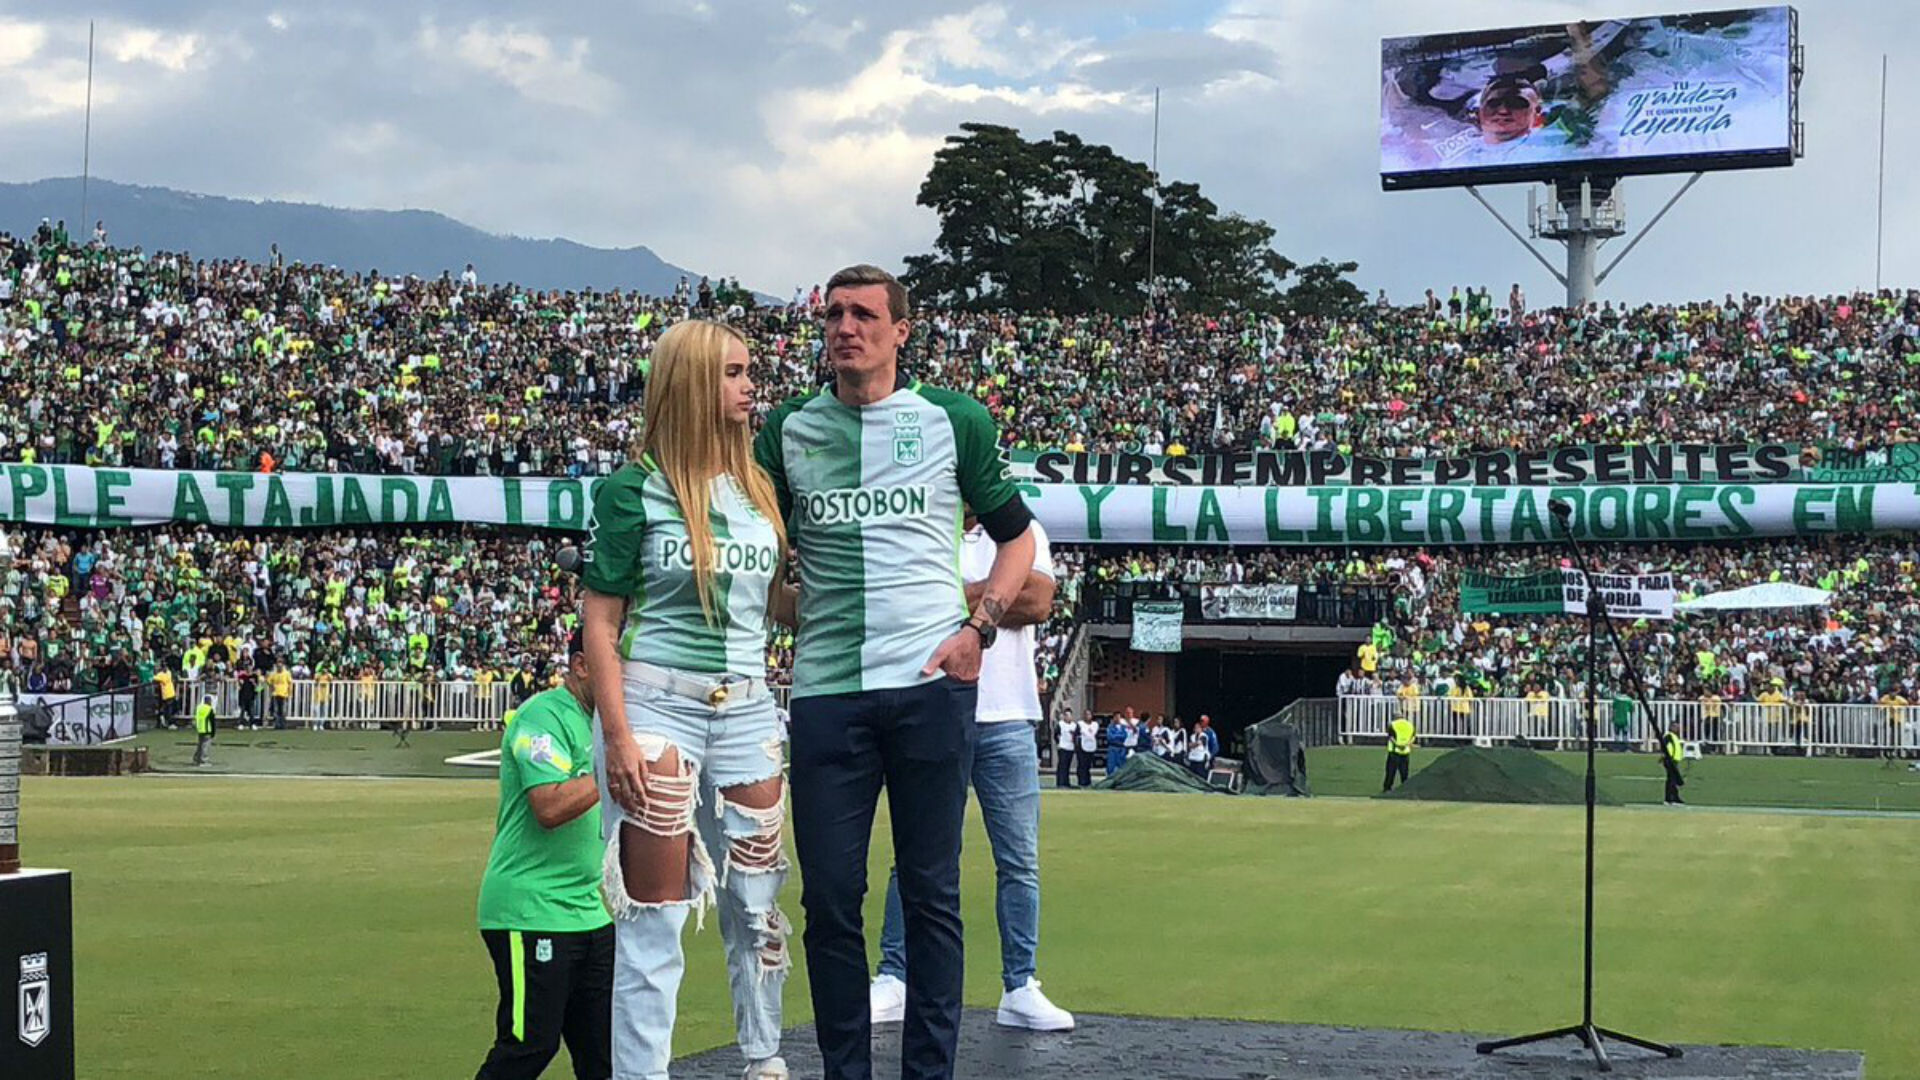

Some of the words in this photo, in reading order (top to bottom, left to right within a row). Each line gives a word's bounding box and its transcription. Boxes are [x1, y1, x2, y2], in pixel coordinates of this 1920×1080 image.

[1672, 81, 1690, 91] TU
[1619, 104, 1732, 145] leyenda
[1034, 451, 1153, 486] SUR
[1163, 450, 1424, 486] SIEMPRE
[1434, 444, 1791, 486] PRESENTES
[0, 464, 132, 528] PLE
[170, 472, 455, 528] ATAJADA
[503, 477, 602, 530] LO
[1078, 485, 1116, 540] Y
[1152, 485, 1230, 542] LA
[1264, 484, 1756, 543] LIBERTADORES
[1792, 484, 1876, 532] EN
[798, 485, 926, 523] POSTOBON
[663, 539, 778, 572] POTOBO
[1566, 587, 1585, 603] DE
[1637, 575, 1670, 591] PARA
